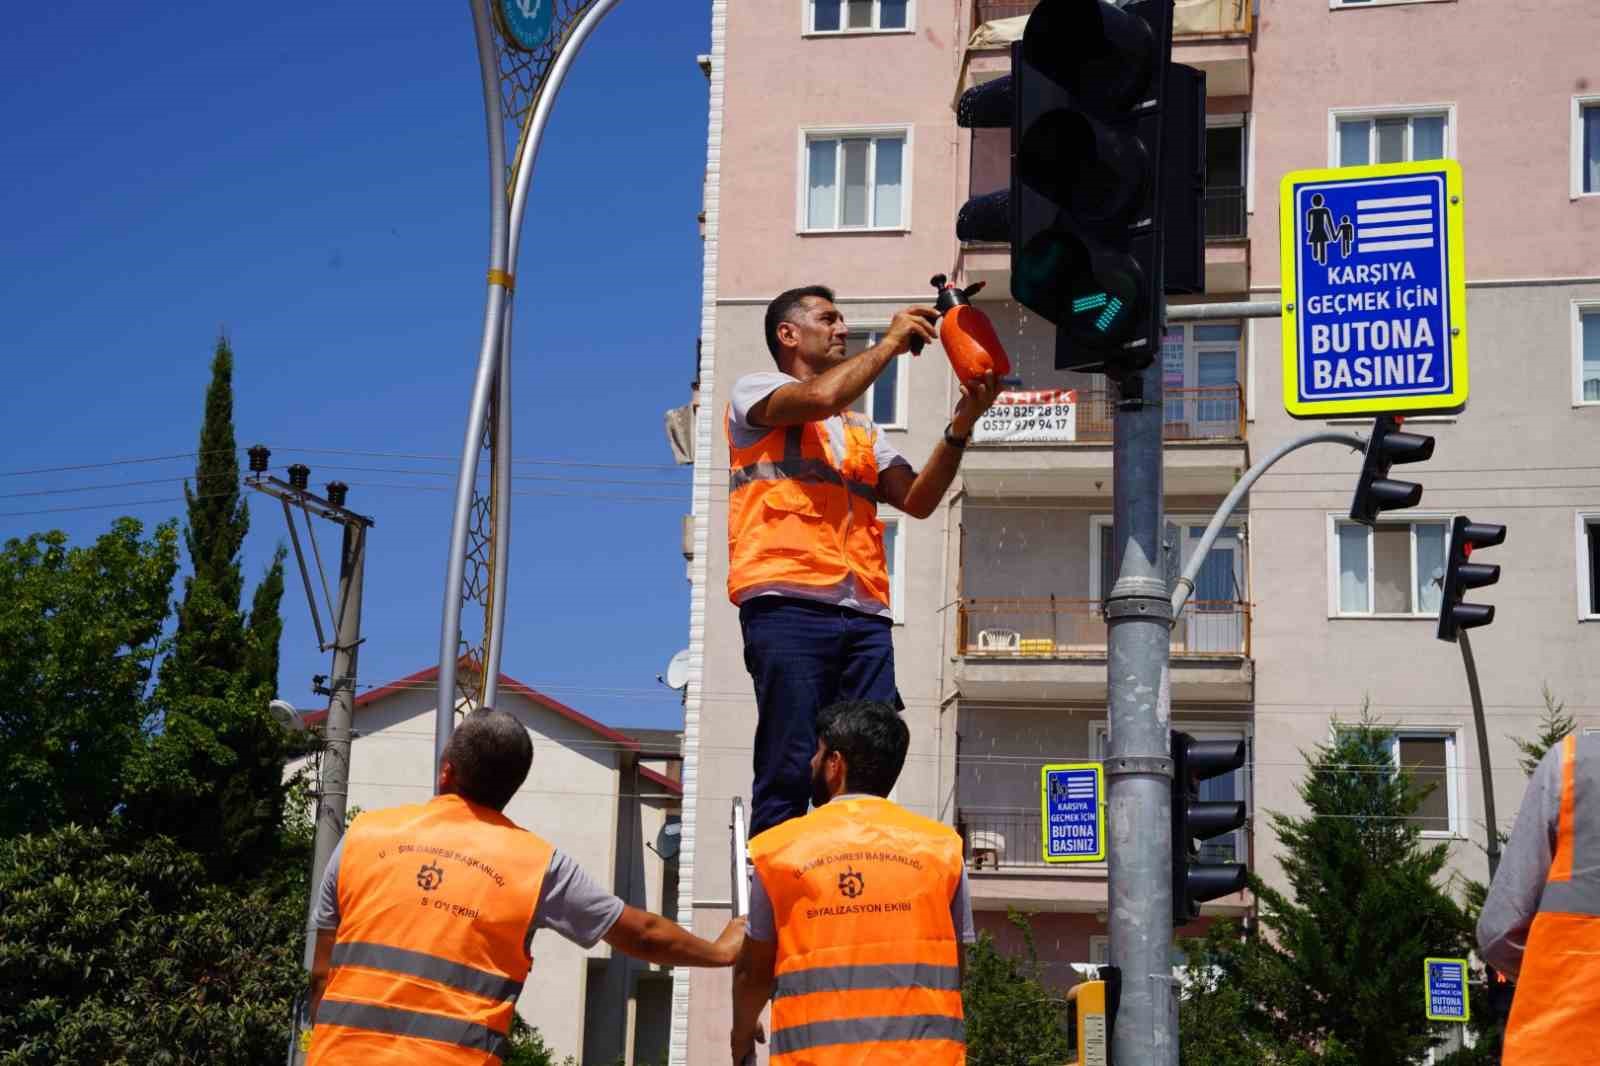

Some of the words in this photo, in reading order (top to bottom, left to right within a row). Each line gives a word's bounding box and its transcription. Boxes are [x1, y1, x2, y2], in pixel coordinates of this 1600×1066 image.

[1327, 261, 1416, 285] KARŞIYA
[1307, 290, 1391, 315] GEÇMEK
[1396, 285, 1438, 311] İÇİN
[1311, 317, 1435, 354] BUTONA
[1313, 353, 1434, 389] BASINIZ
[1013, 406, 1034, 418] 825
[983, 420, 1011, 431] 0537
[1039, 420, 1053, 430] 94
[1056, 420, 1067, 430] 17
[1052, 824, 1094, 838] BUTONA
[1052, 838, 1094, 852] BASINIZ
